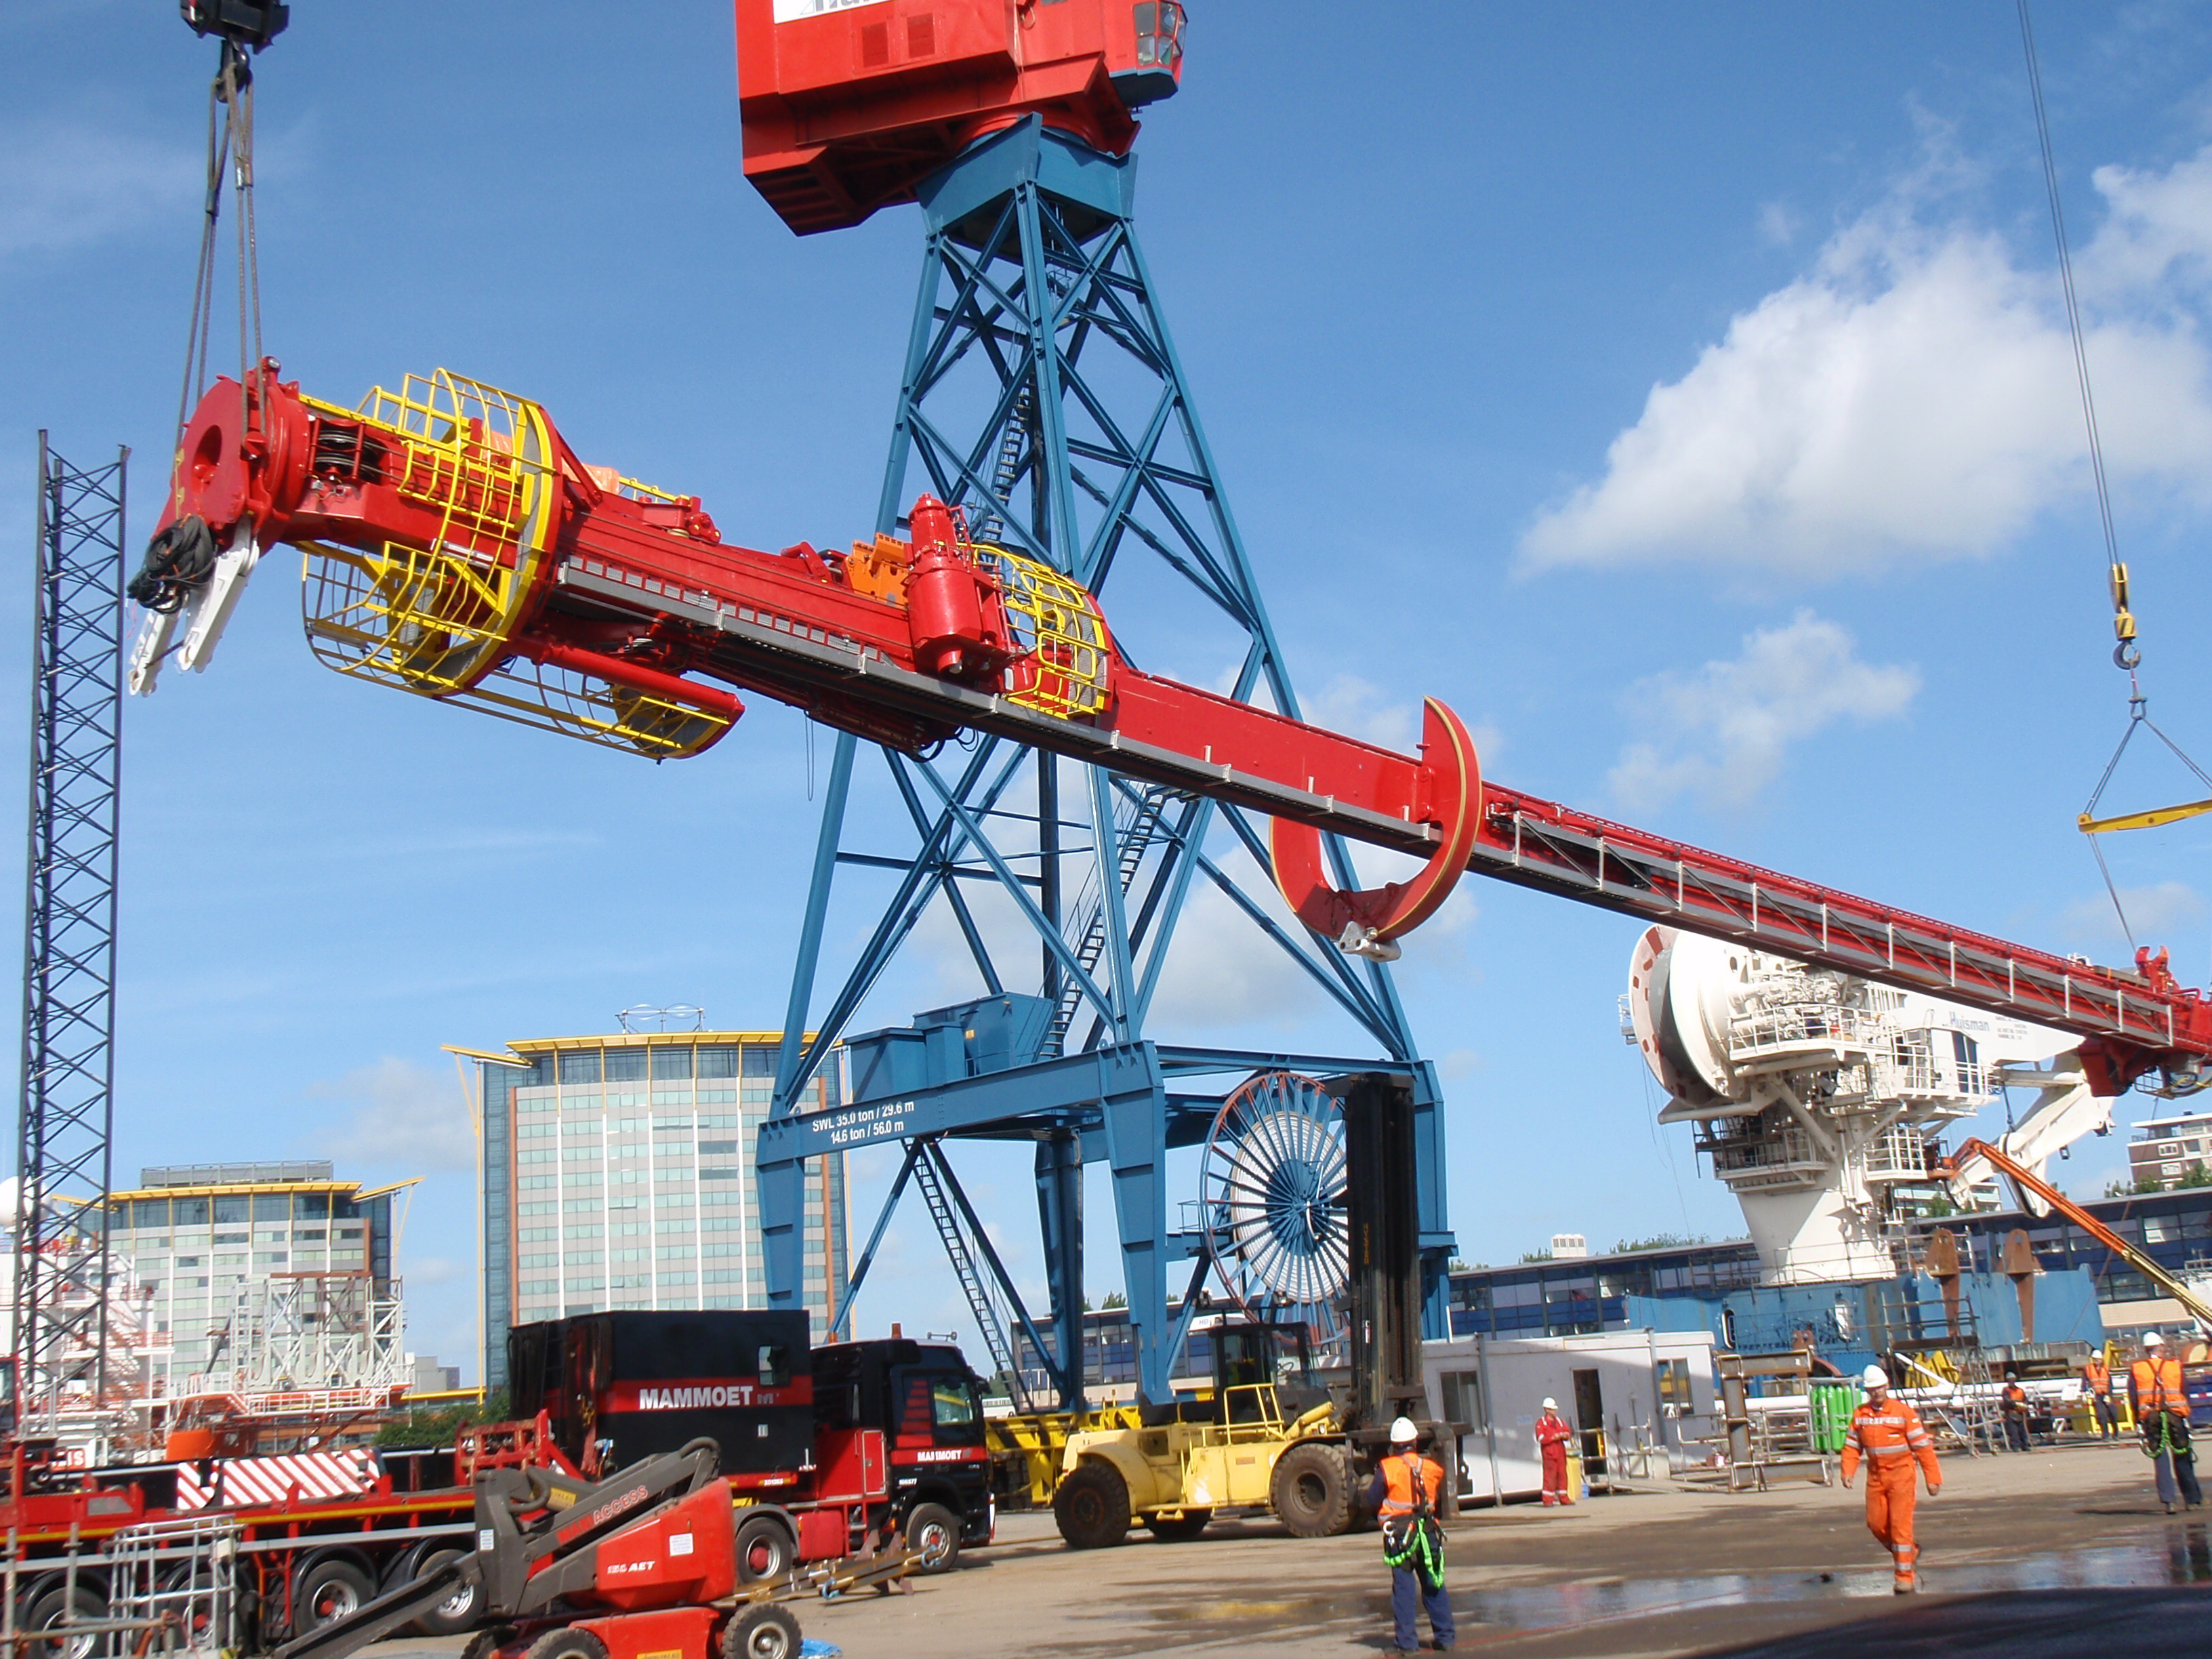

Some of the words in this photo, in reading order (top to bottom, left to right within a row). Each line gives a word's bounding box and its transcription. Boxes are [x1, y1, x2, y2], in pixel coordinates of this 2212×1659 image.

[813, 1120, 834, 1132] SWL
[836, 1112, 856, 1126] 35.0
[858, 1110, 874, 1122] ton
[876, 1105, 880, 1118] /
[882, 1101, 903, 1118] 29.6
[904, 1101, 914, 1111] m
[830, 1130, 848, 1144] 14.6
[850, 1128, 865, 1141] ton
[867, 1124, 871, 1137] /
[873, 1120, 892, 1136] 56.0
[895, 1121, 904, 1132] m
[639, 1386, 754, 1410] MAMMOET
[917, 1450, 962, 1462] MAMMOET
[628, 1561, 655, 1572] AET
